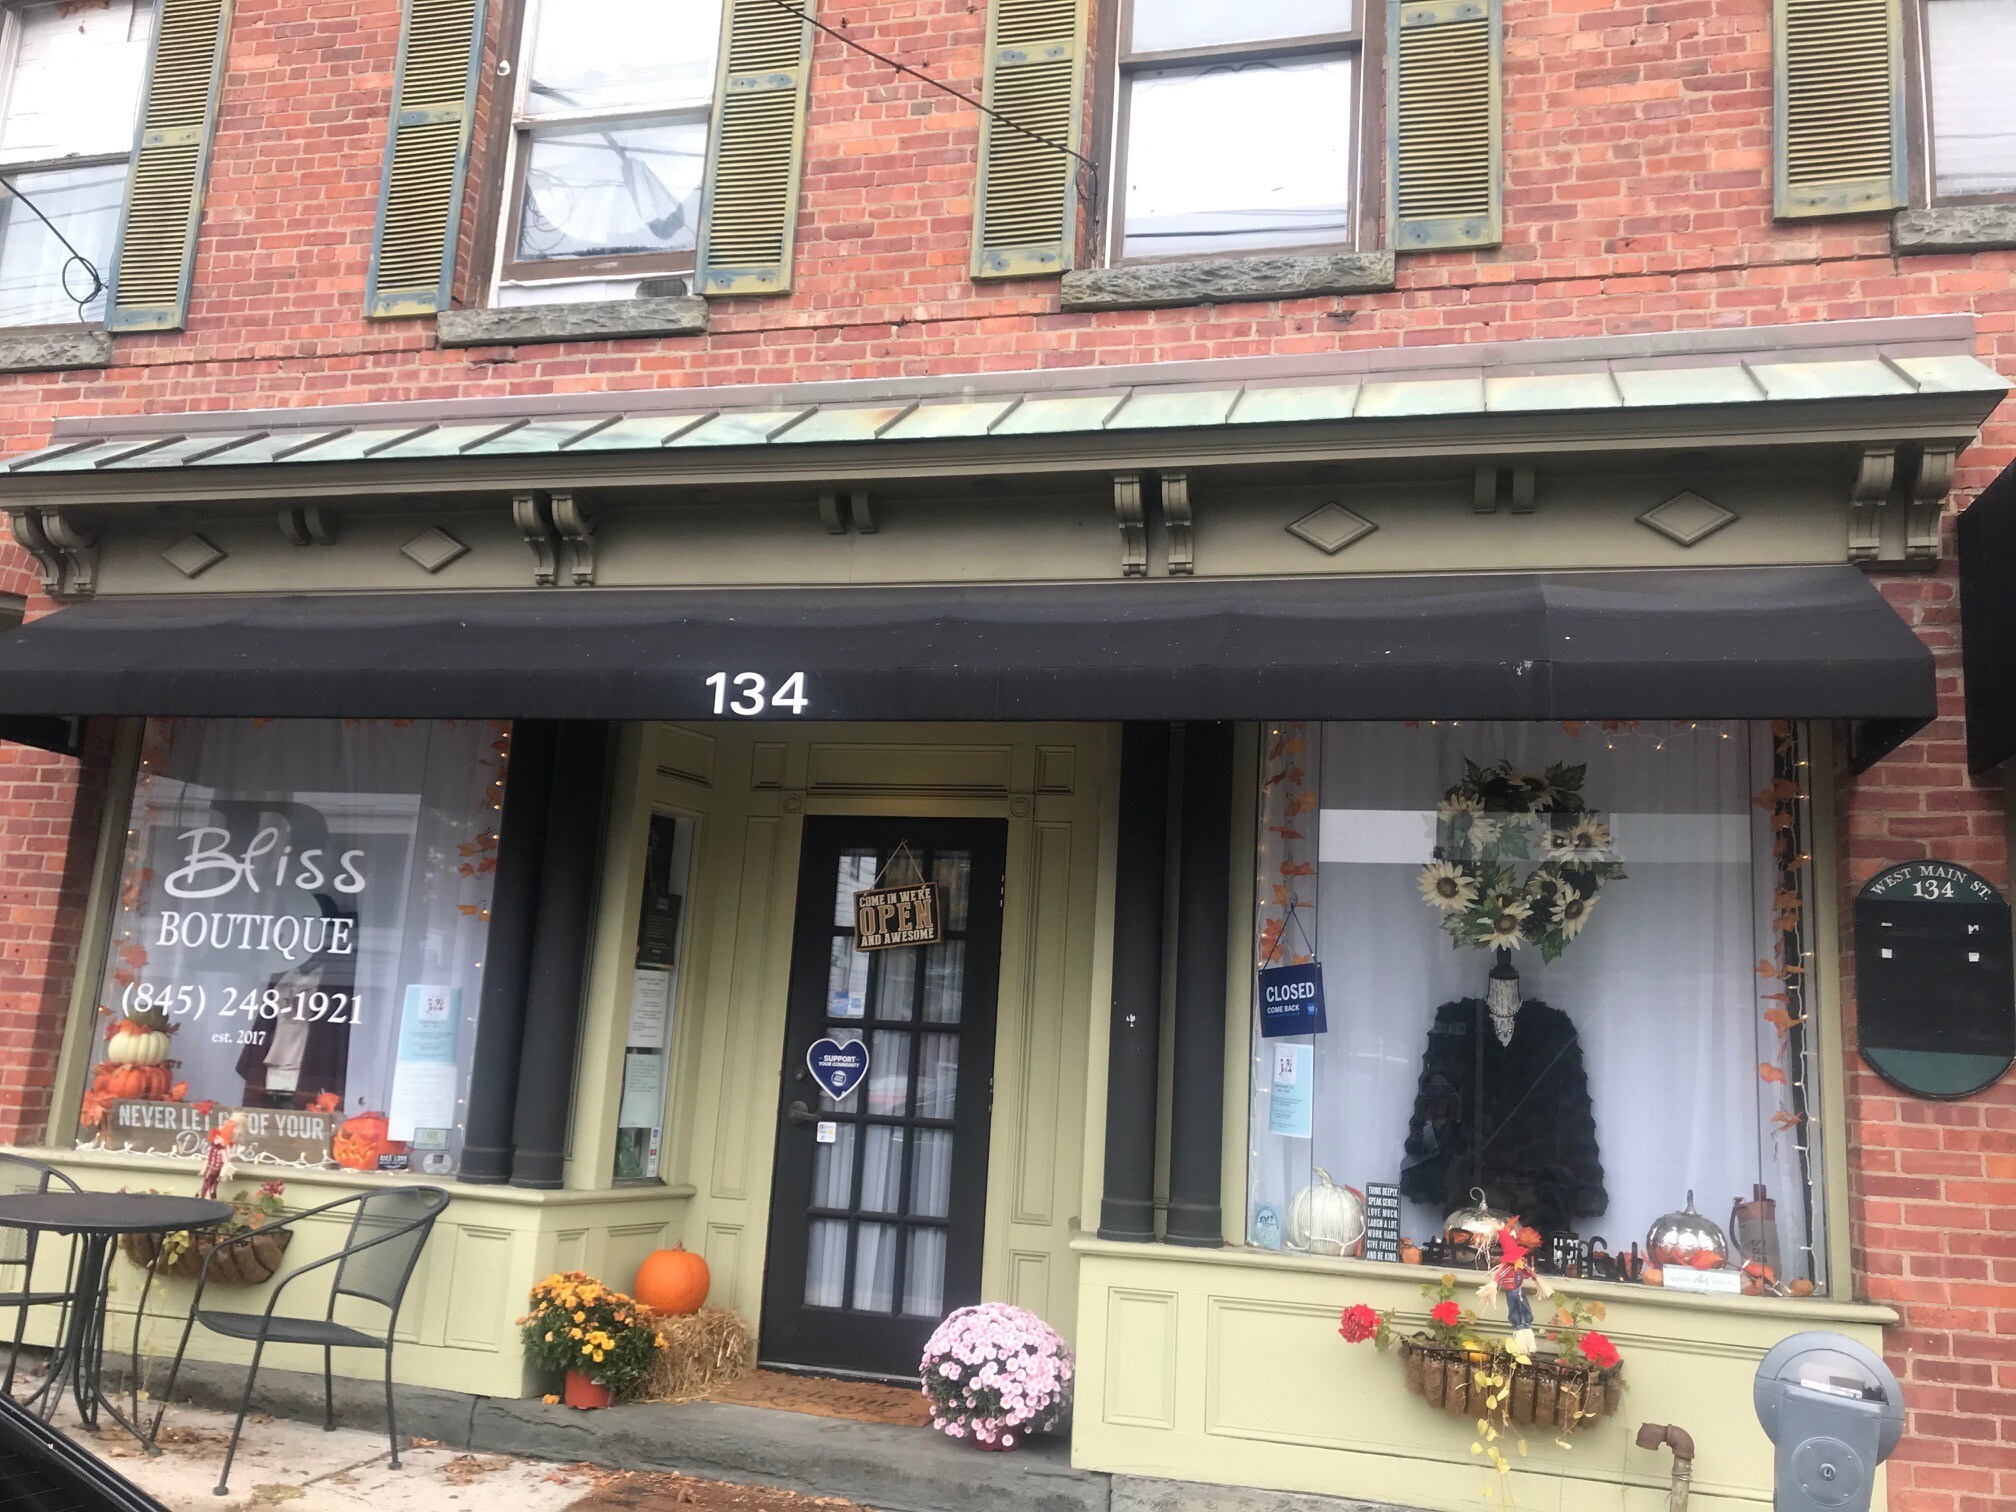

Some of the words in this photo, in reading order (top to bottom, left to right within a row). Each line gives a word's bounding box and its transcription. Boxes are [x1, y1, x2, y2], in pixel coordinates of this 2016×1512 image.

[705, 671, 808, 715] 134
[164, 826, 366, 898] Bliss
[1870, 867, 1912, 895] WEST
[1918, 865, 1967, 884] MAIN
[1970, 880, 1992, 900] ST.
[1912, 879, 1955, 900] 134
[859, 894, 886, 908] COME
[887, 892, 898, 904] IN
[899, 887, 932, 902] WE'RE
[859, 898, 934, 936] OPEN
[156, 910, 353, 960] BOUTIQUE
[860, 934, 882, 947] AND
[883, 928, 935, 945] AWESOME
[1266, 981, 1316, 1002] CLOSED
[121, 981, 206, 1022] (845)
[218, 986, 363, 1025] 248-1921
[1266, 1005, 1284, 1014] COME
[1284, 1004, 1300, 1012] BACK
[211, 1031, 233, 1043] est.
[233, 1029, 267, 1046] 2017
[823, 1054, 857, 1062] SUPPORT
[118, 1104, 177, 1130] NEVER
[248, 1112, 270, 1135] OF
[274, 1113, 325, 1140] YOUR
[1368, 1185, 1382, 1195] THINK
[1368, 1197, 1382, 1206] SPEAK
[1367, 1207, 1381, 1217] LOVE
[1367, 1218, 1383, 1227] LAUGH
[1384, 1219, 1388, 1228] A
[1367, 1229, 1383, 1239] WORK
[1366, 1240, 1379, 1249] GIVE
[1366, 1250, 1377, 1260] AND
[1377, 1251, 1384, 1261] BE
